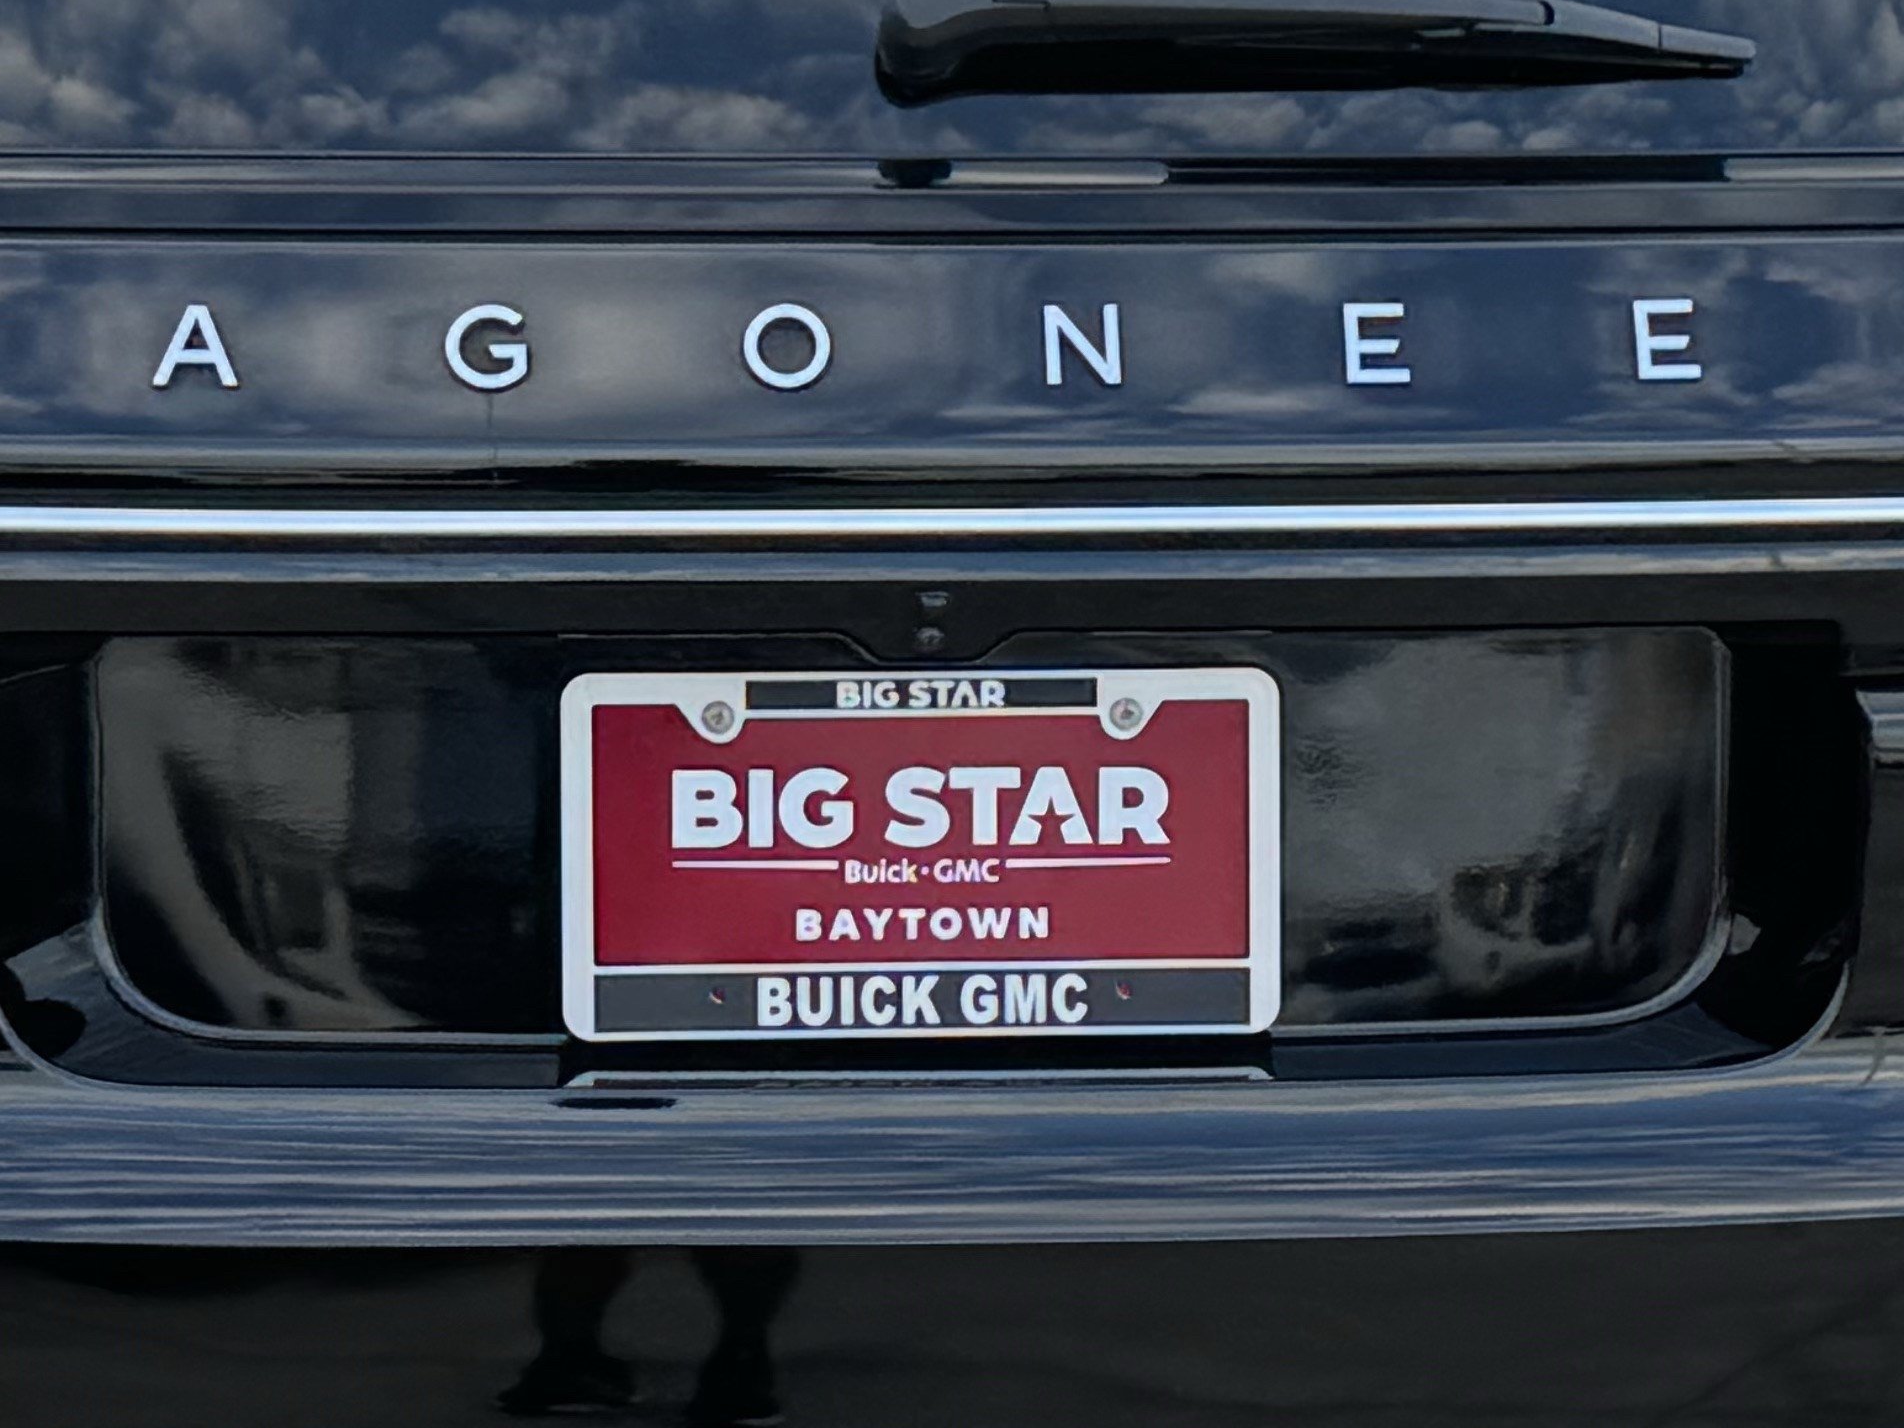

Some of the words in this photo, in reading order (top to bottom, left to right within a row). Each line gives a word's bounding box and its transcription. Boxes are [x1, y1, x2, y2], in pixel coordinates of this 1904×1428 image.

[836, 680, 900, 708] BIG
[908, 679, 1005, 708] STAR
[671, 766, 855, 849] BIG
[883, 765, 1172, 848] STAR
[794, 906, 1050, 942] BAYTOWN
[756, 976, 941, 1028] BUICK
[959, 973, 1089, 1025] GMC
